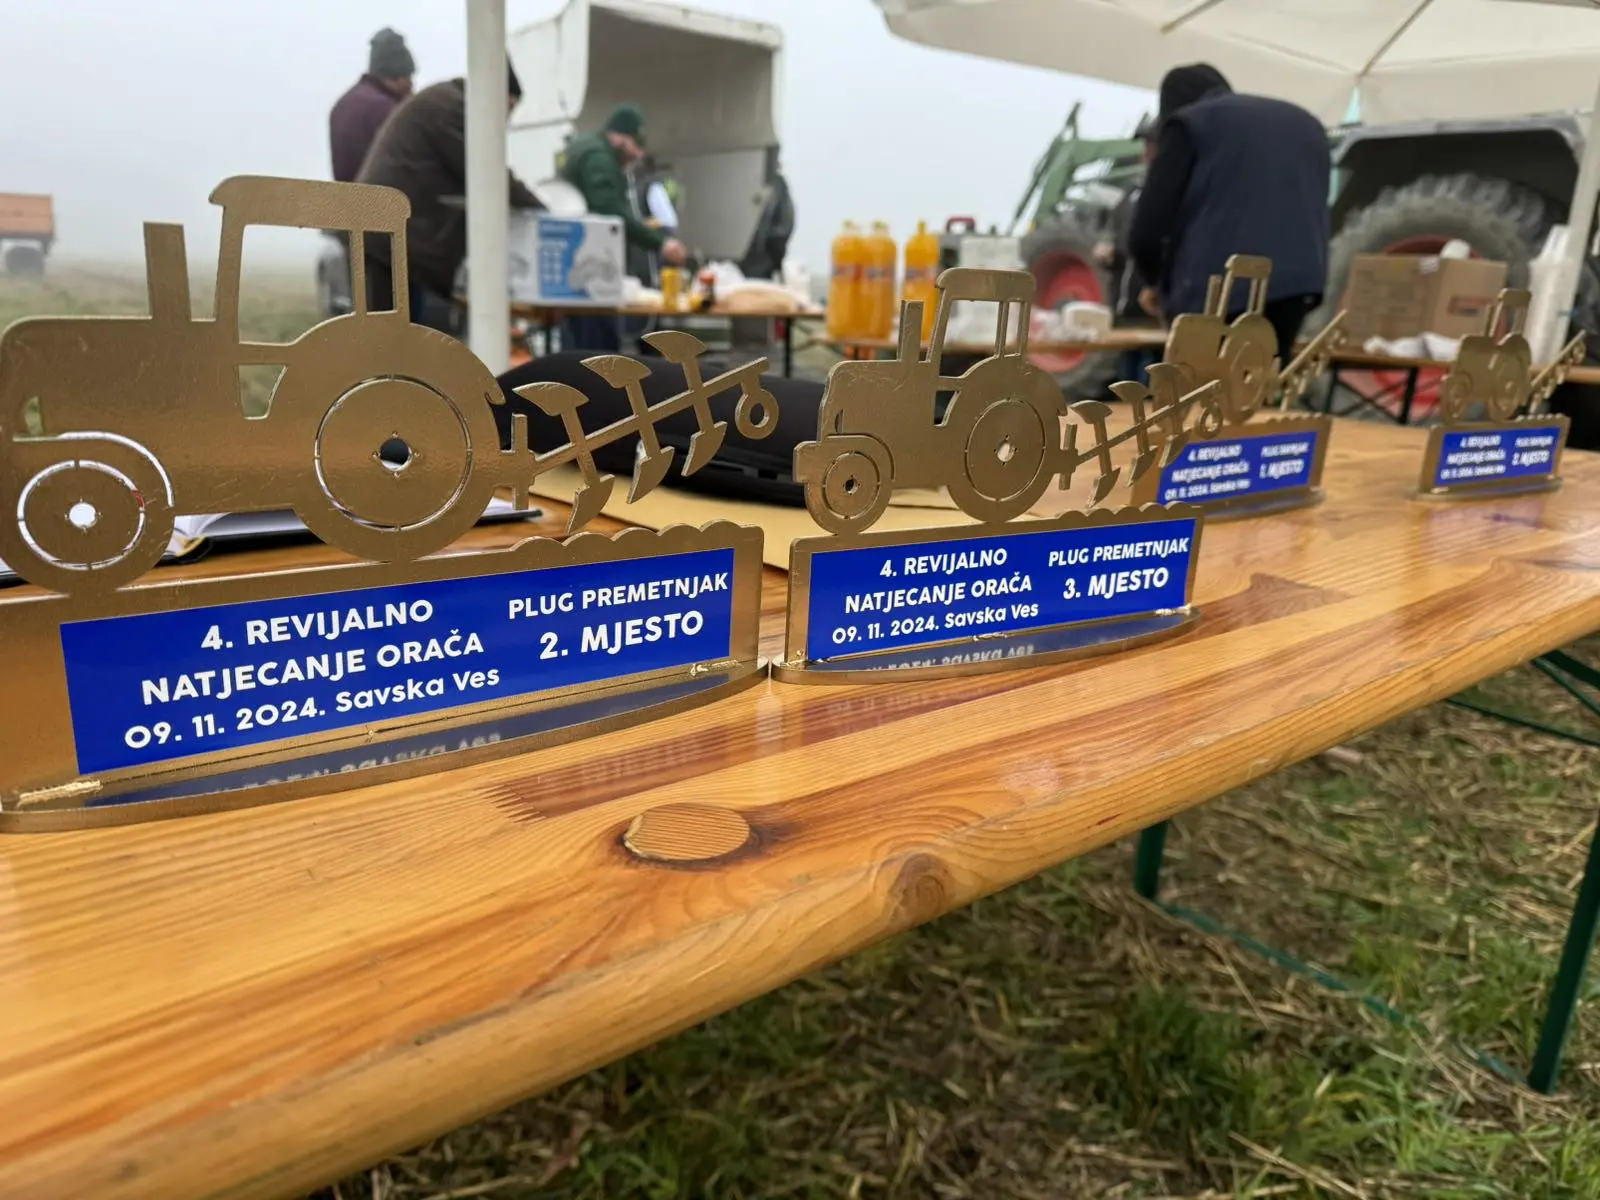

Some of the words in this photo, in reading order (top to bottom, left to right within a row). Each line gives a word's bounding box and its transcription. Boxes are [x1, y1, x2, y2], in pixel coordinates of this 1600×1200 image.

[879, 559, 897, 578] 4.
[904, 548, 1007, 575] REVIJALNO
[1048, 547, 1089, 567] PLUG
[1093, 537, 1189, 562] PREMETNJAK
[509, 592, 574, 620] PLUG
[582, 572, 728, 609] PREMETNJAK
[845, 582, 966, 614] NATJECANJE
[971, 571, 1032, 598] ORAČA
[1063, 577, 1081, 600] 3.
[1087, 567, 1169, 599] MJESTO
[201, 625, 233, 650] 4.
[246, 599, 433, 645] REVIJALNO
[539, 631, 569, 660] 2.
[580, 610, 704, 655] MJESTO
[832, 625, 862, 644] 09.
[867, 622, 885, 640] 11.
[890, 615, 939, 637] 2024.
[944, 606, 1007, 630] Savska
[1011, 603, 1039, 619] Ves
[141, 648, 366, 705] NATJECANJE
[376, 628, 484, 668] ORAČA
[124, 721, 182, 749] 09.
[191, 713, 225, 738] 11.
[236, 697, 326, 731] 2024.
[335, 678, 444, 713] Savska
[452, 669, 500, 691] Ves
